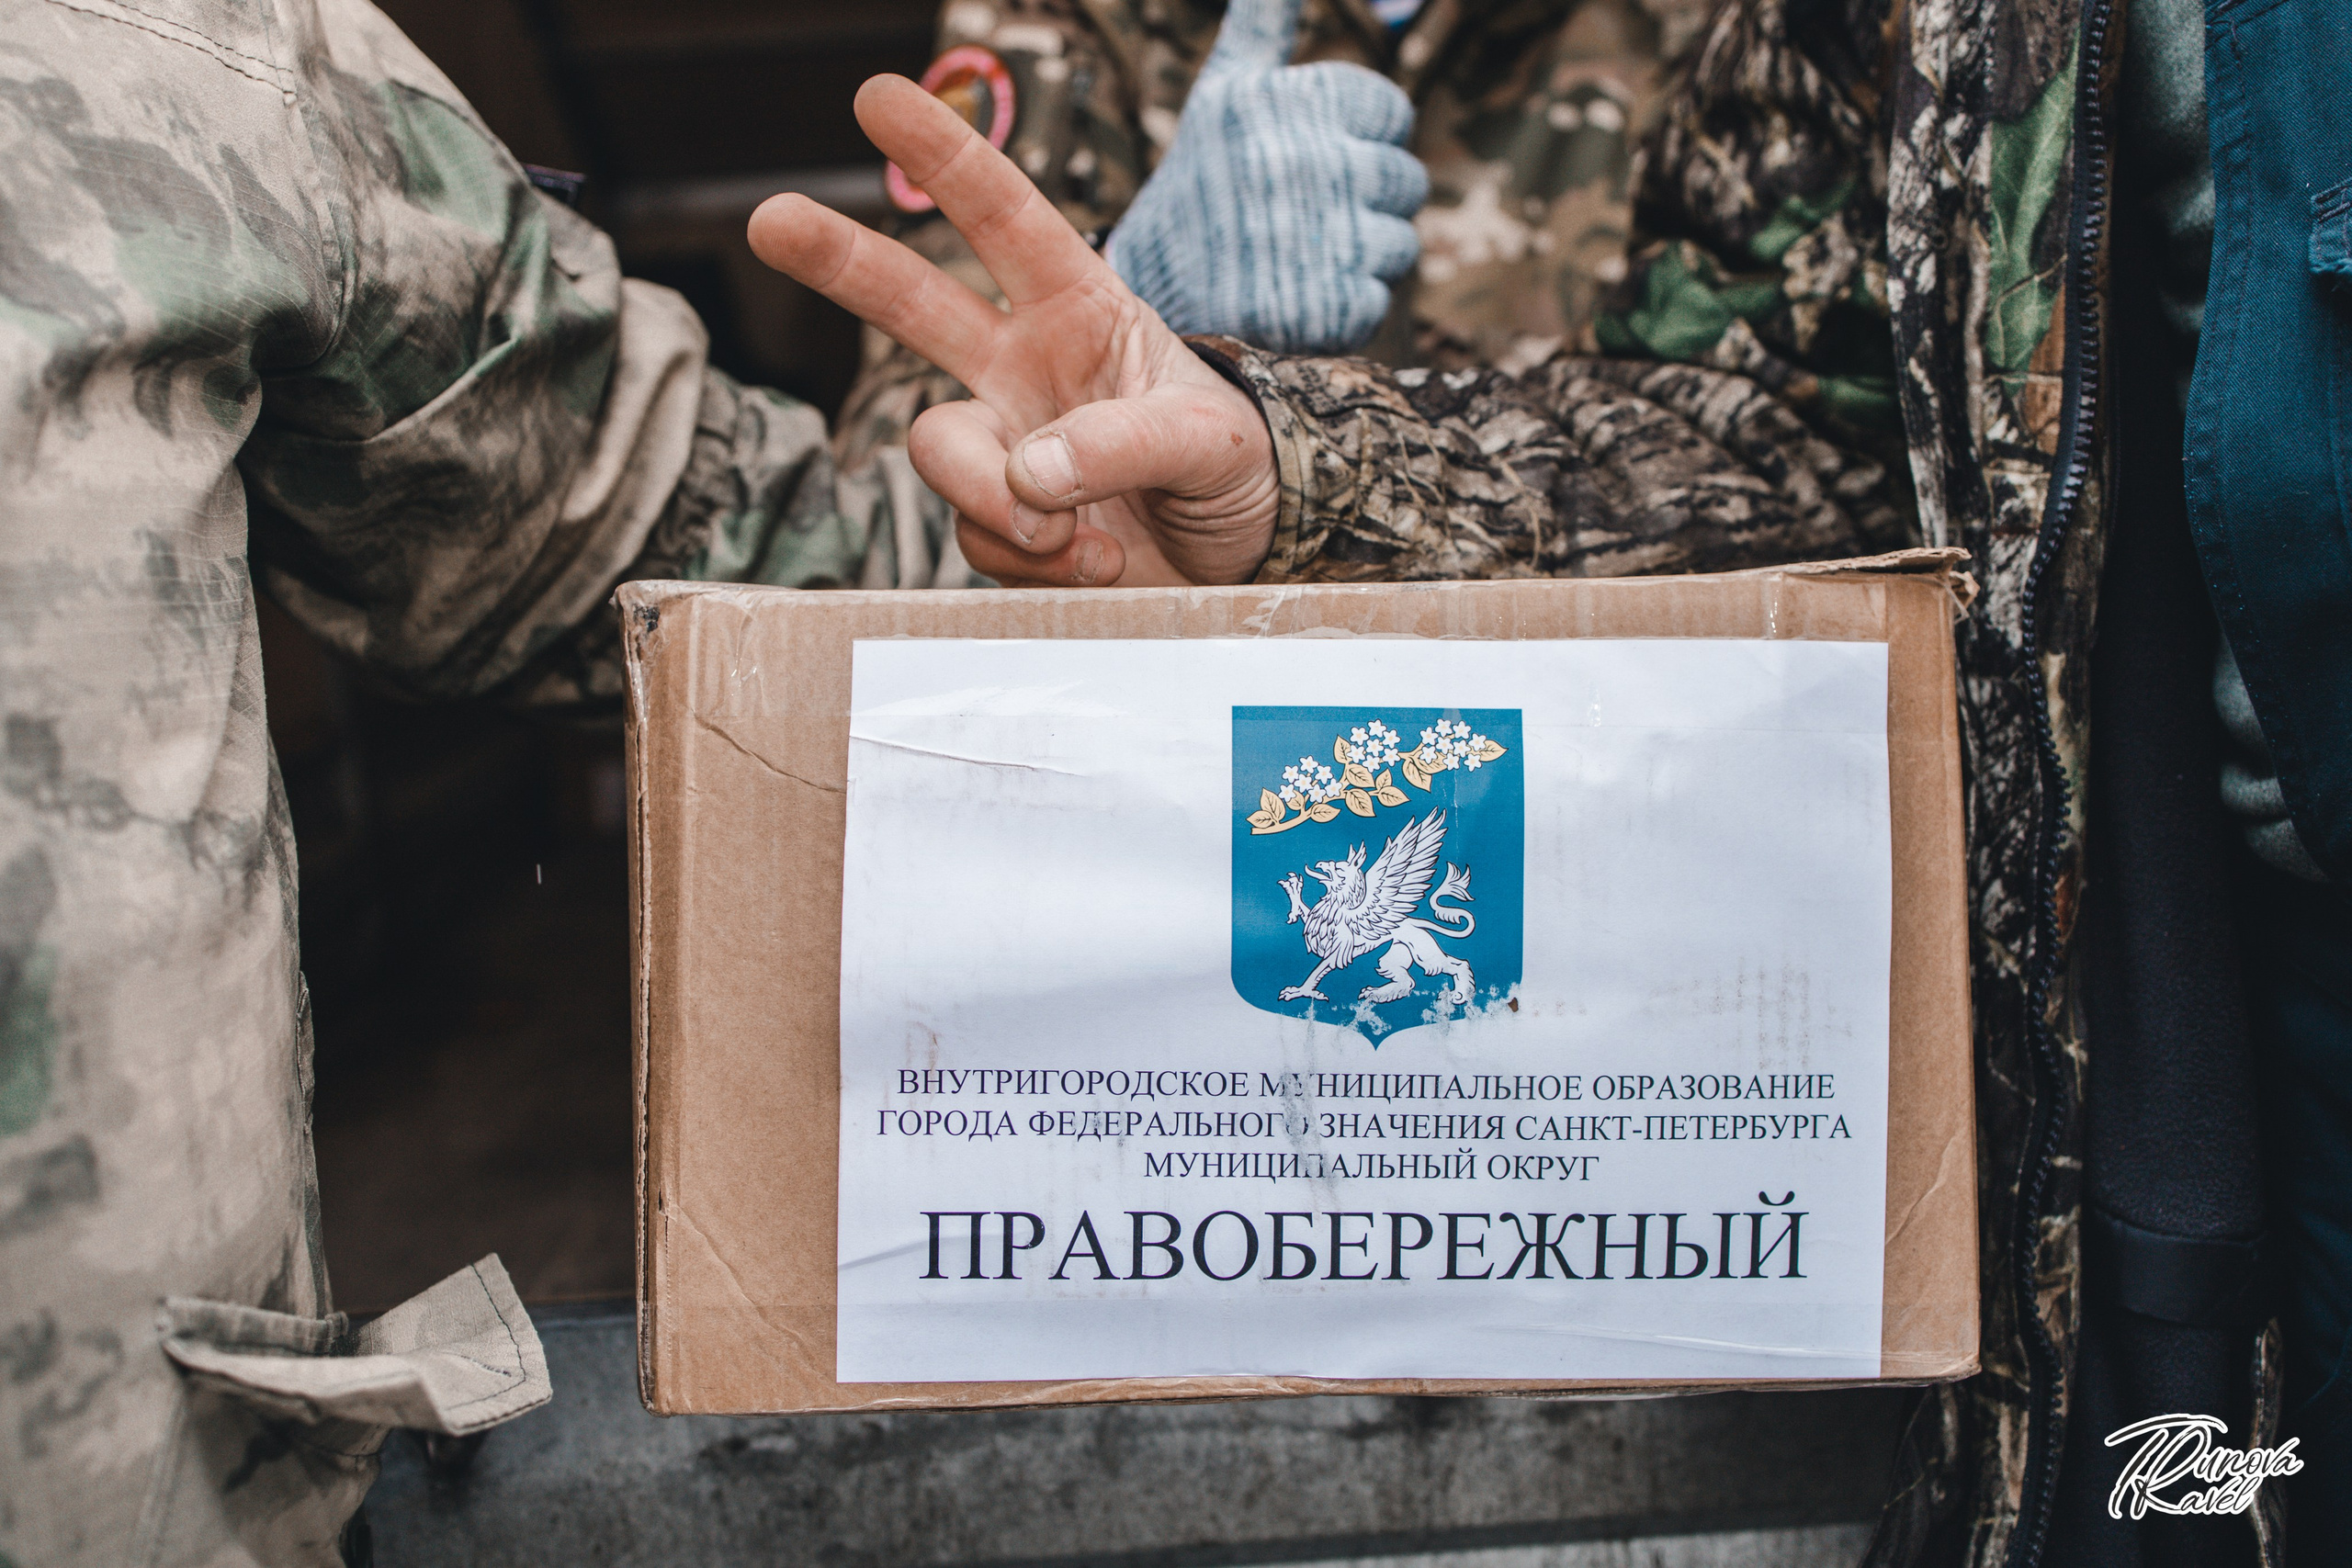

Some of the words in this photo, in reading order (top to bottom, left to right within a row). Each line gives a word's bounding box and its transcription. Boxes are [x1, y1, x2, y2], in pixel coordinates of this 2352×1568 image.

[897, 1068, 1250, 1102] ВНУТРИГОРОДСКОЕ
[1592, 1074, 1836, 1100] ОБРАЗОВАНИЕ
[876, 1109, 1019, 1143] ГОРОДА
[1319, 1112, 1507, 1141] ЗНАЧЕНИЯ
[1515, 1113, 1852, 1141] САНКТ-ПЕТЕРБУРГА
[1143, 1146, 1477, 1184] МУНИЦИПАЛЬНЫЙ
[1487, 1154, 1600, 1181] ОКРУГ
[919, 1190, 1810, 1282] ПРАВОБЕРЕЖНЫЙ
